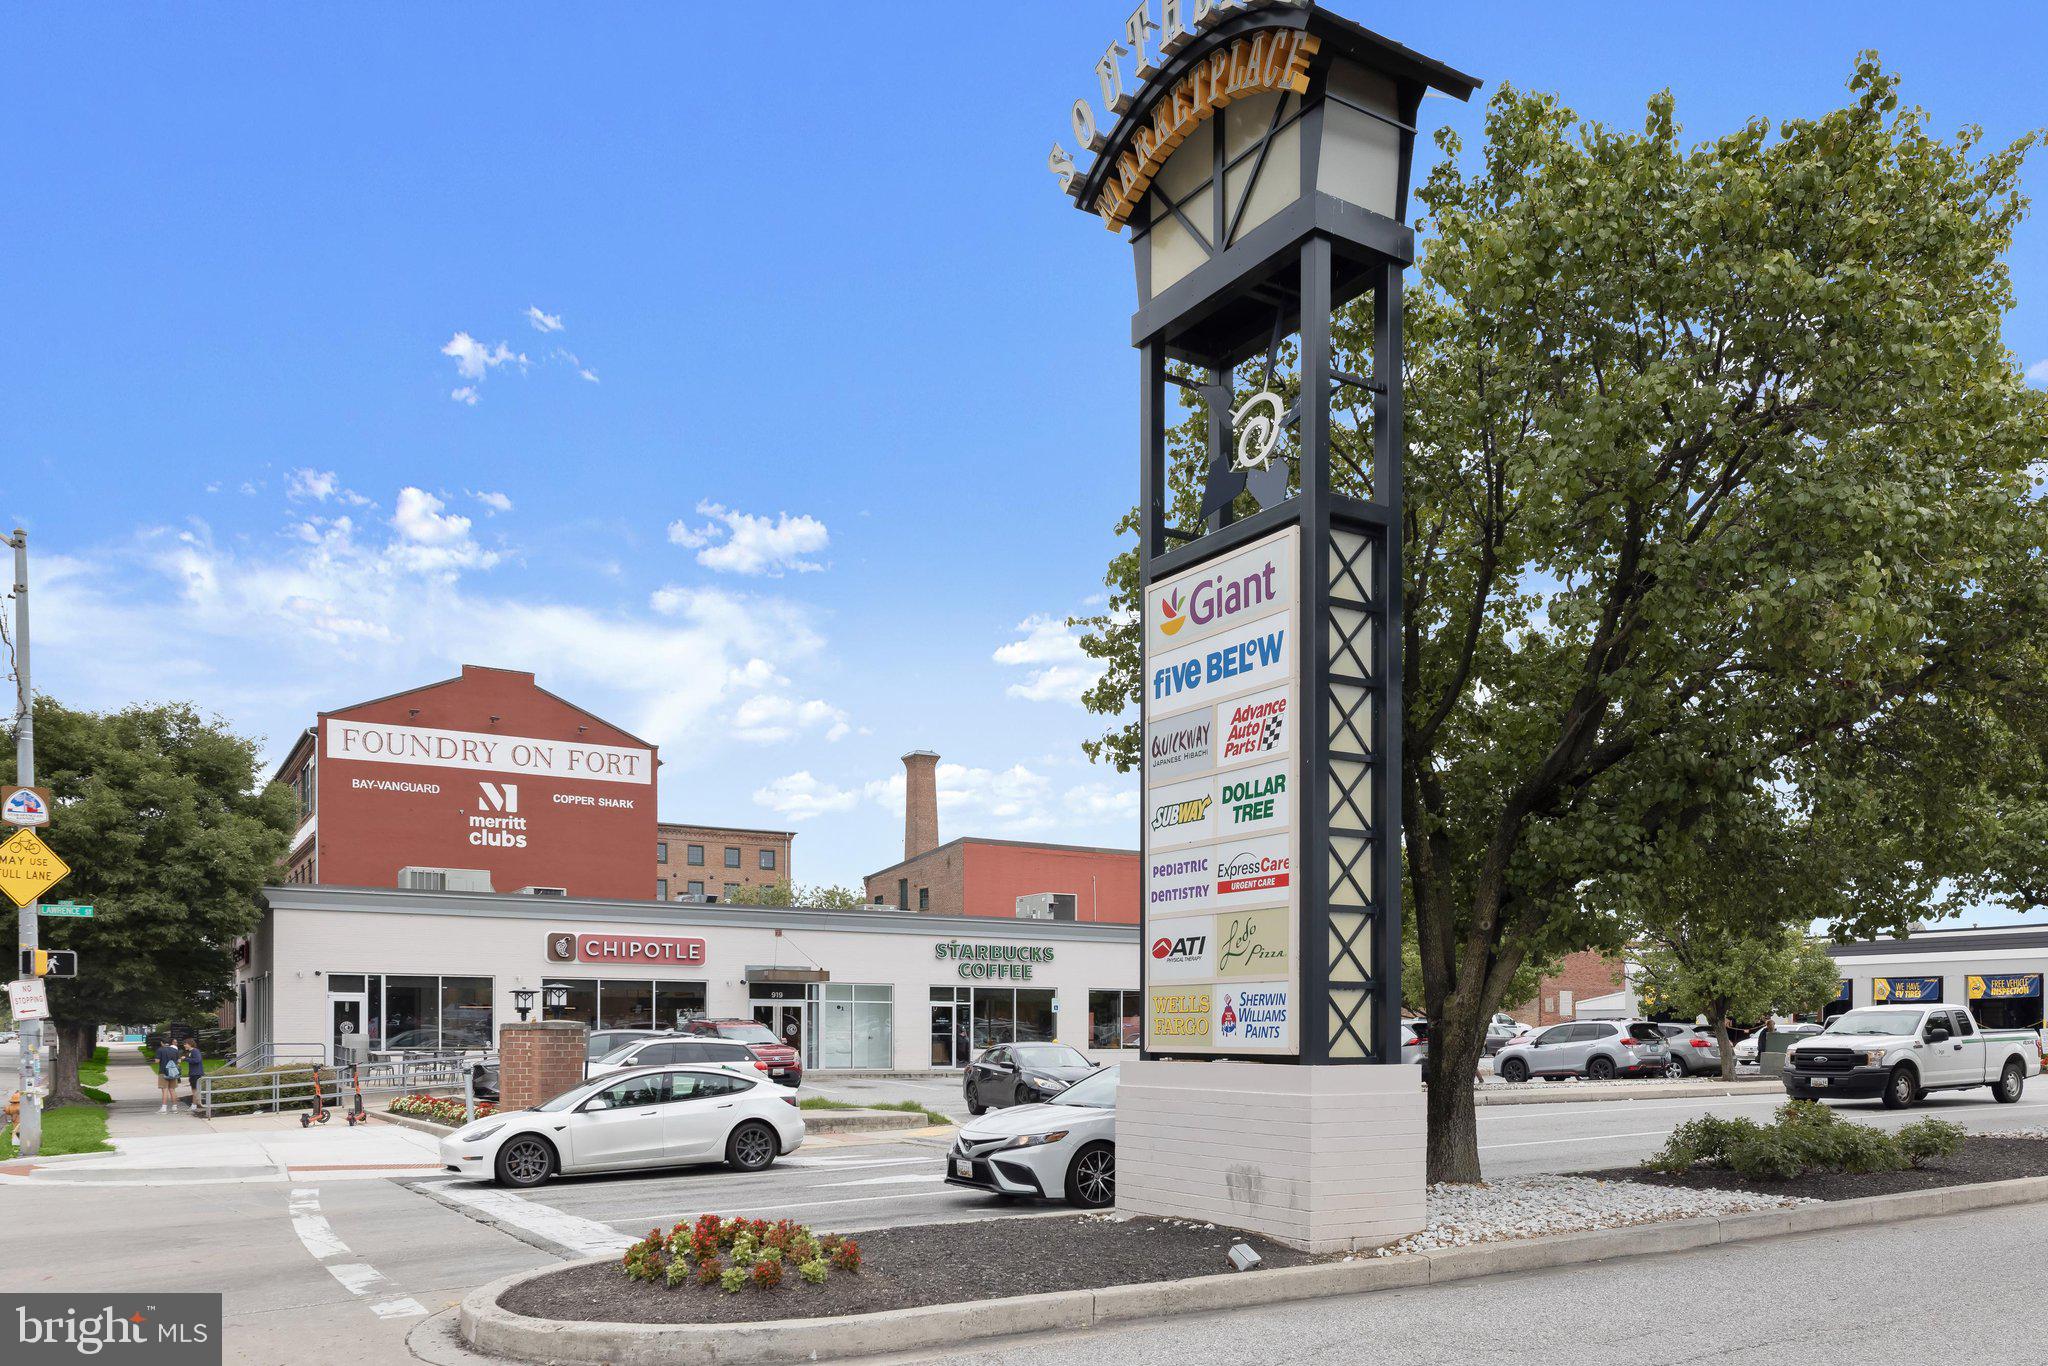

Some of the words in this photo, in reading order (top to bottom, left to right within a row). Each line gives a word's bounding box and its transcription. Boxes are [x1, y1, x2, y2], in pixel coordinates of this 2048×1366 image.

[1093, 28, 1321, 234] MARKETPLACE
[1190, 560, 1277, 625] Giant
[1206, 630, 1284, 684] BELOW
[1231, 698, 1287, 726] Advance
[1152, 721, 1210, 758] QUICKWAY
[1227, 722, 1260, 742] Auto
[340, 727, 498, 765] FOUNDRY
[510, 744, 553, 769] ON
[567, 749, 640, 776] FORT
[1224, 738, 1256, 758] Parts
[1152, 755, 1182, 768] JAPANESE
[1183, 749, 1209, 761] HIBACHI
[351, 778, 441, 795] BAY-VANGUARD
[1222, 773, 1287, 805] DOLLAR
[553, 793, 596, 807] COPPER
[597, 797, 635, 809] SHARK
[1233, 798, 1274, 824] TREE
[469, 814, 527, 831] merritt
[1151, 794, 1213, 831] SUBWAY
[469, 829, 527, 848] clubs
[0, 855, 25, 865] MAY
[30, 858, 48, 867] USE
[1217, 856, 1289, 880] ExpressCare
[26, 870, 52, 881] LANE
[1231, 879, 1258, 890] URGENT
[1257, 877, 1276, 887] CARE
[585, 940, 701, 960] CHIPOTLE
[935, 942, 1055, 962] STARBUCKS
[1169, 936, 1206, 957] ATI
[1219, 917, 1257, 970] Ledo
[958, 962, 1033, 980] COFFEE
[1895, 982, 1905, 991] WE
[1906, 982, 1920, 991] HAVE
[1990, 987, 2029, 996] INSPECTION
[1991, 980, 2005, 988] FREE
[2006, 978, 2029, 988] VEHICLE
[15, 995, 44, 1005] STOPPING
[1153, 994, 1211, 1014] WELLS
[1239, 991, 1287, 1007] SHERWIN
[1904, 990, 1922, 998] TIRES
[1238, 1008, 1287, 1023] WILLIAMS
[1154, 1016, 1210, 1036] FARGO
[1245, 1024, 1280, 1038] PAINTS
